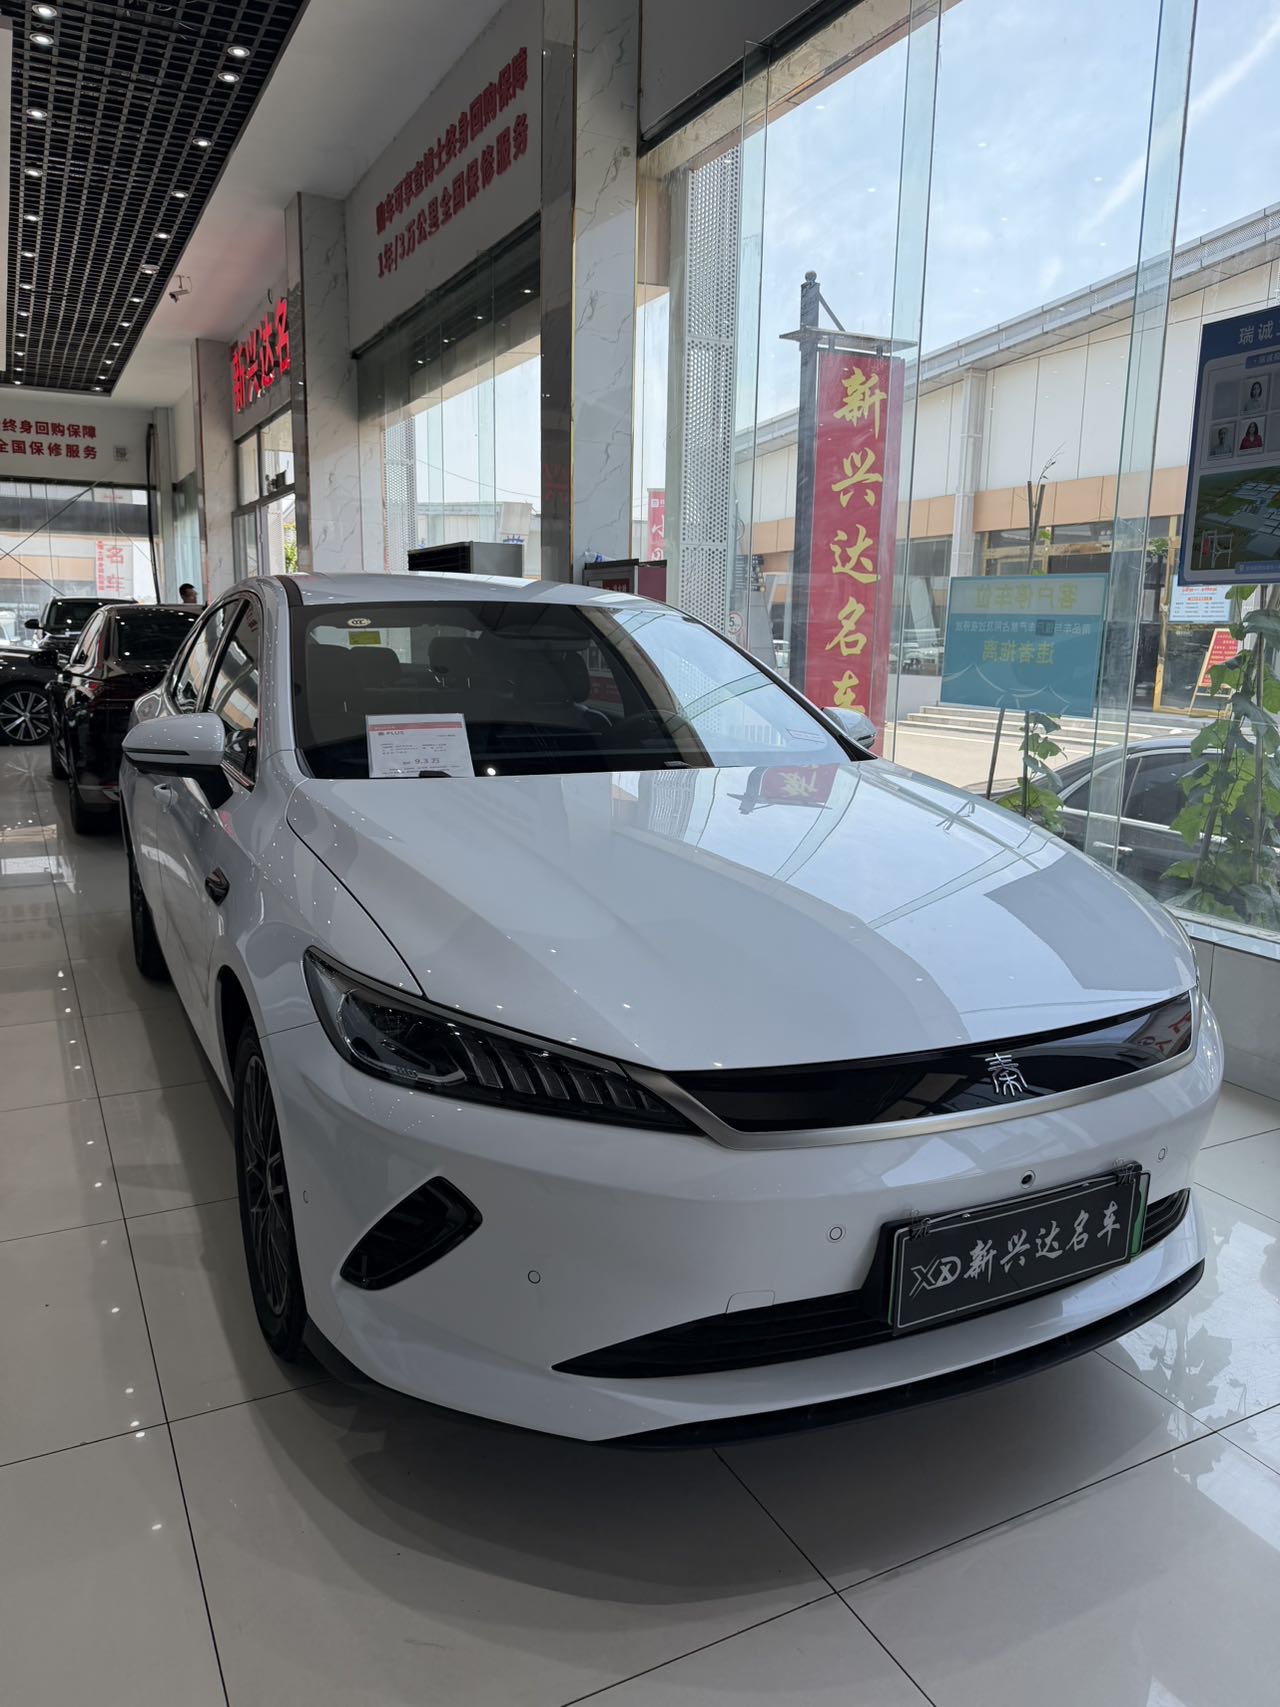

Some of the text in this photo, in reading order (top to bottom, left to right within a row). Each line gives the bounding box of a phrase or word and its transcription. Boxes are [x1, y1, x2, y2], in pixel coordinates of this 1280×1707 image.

[1238, 320, 1280, 345] 瑞诚
[0, 418, 97, 440] 终身回购保障
[825, 366, 887, 714] 新兴达名车
[984, 1053, 1028, 1097] 秦
[964, 1200, 1121, 1283] 新兴达名车
